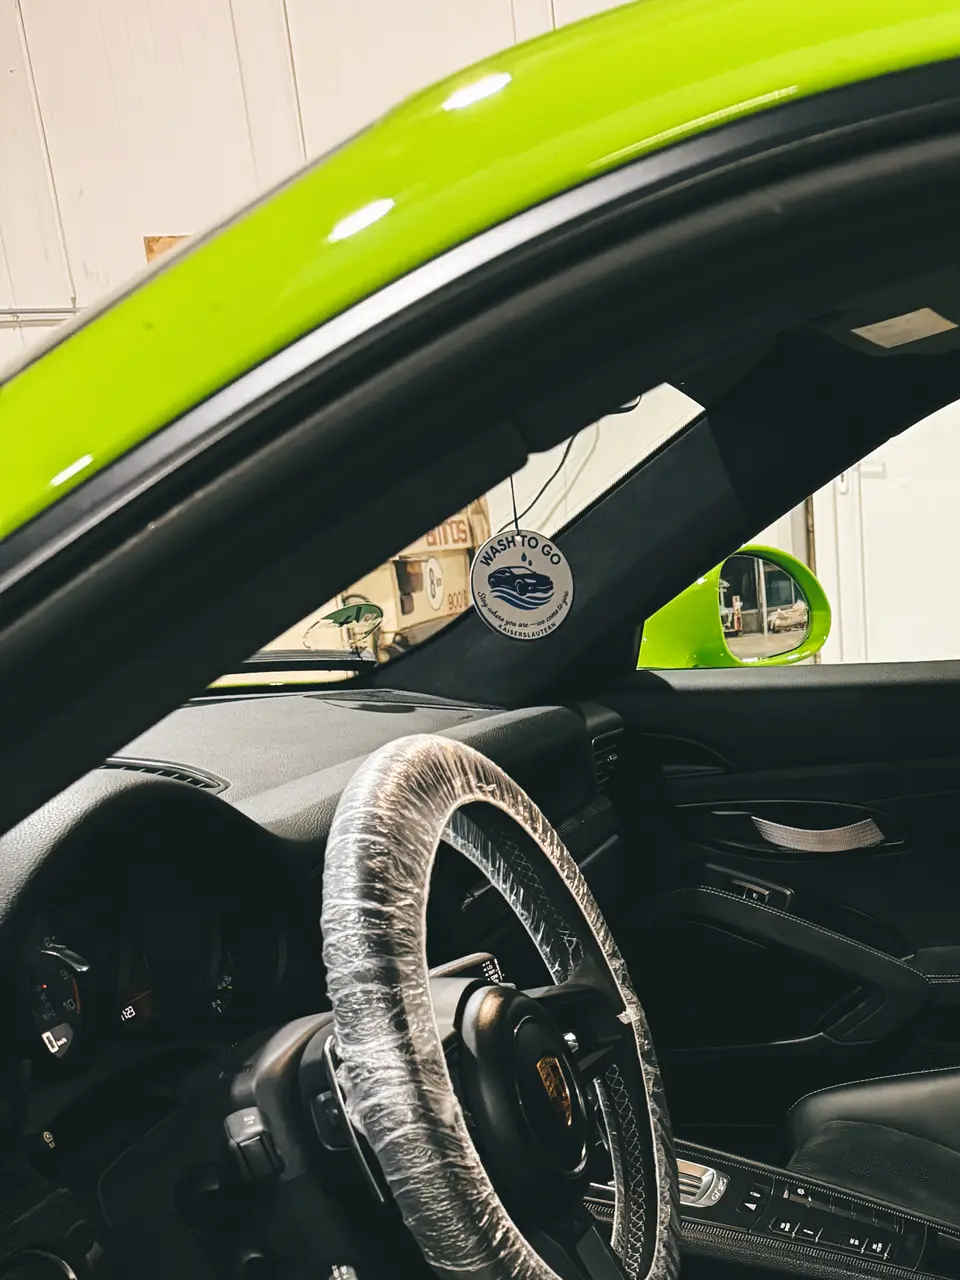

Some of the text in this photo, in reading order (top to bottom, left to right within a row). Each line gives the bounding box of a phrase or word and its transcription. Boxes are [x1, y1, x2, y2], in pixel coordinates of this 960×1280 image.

[480, 535, 561, 567] WASH TO GO
[477, 591, 488, 608] Stay
[488, 607, 505, 623] where
[505, 619, 517, 627] you
[546, 610, 559, 622] come
[561, 591, 569, 607] you
[498, 622, 557, 638] KAISERSLAUTERN
[63, 998, 76, 1012] 10
